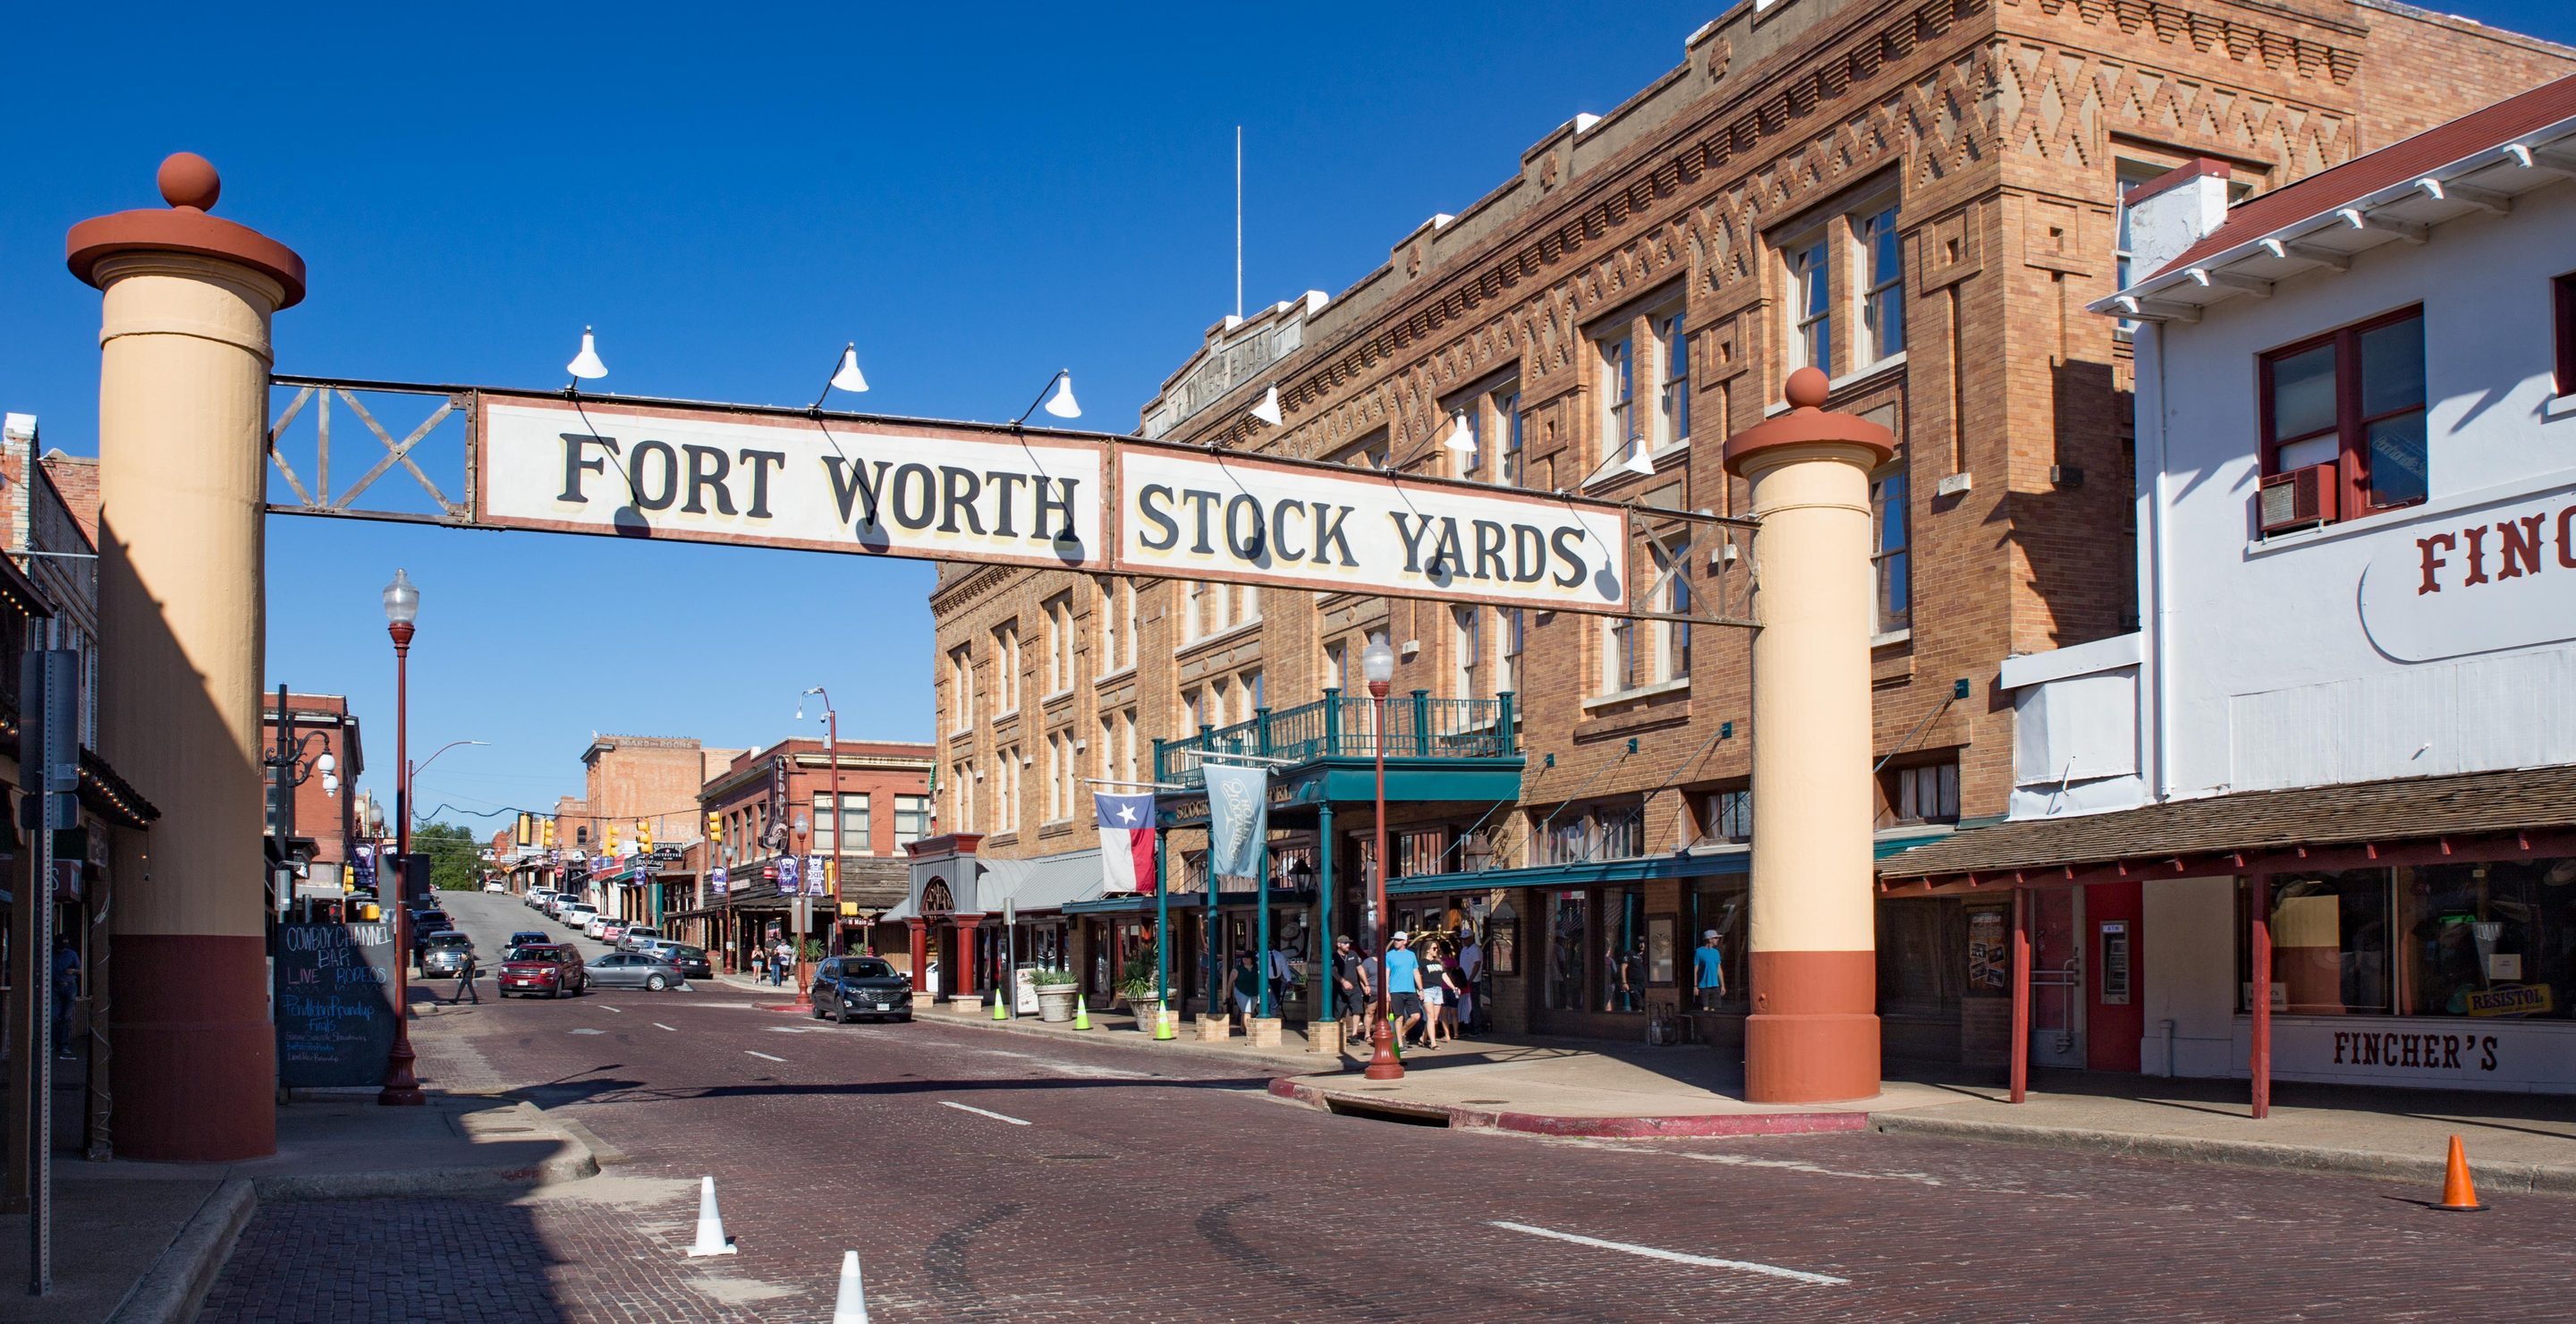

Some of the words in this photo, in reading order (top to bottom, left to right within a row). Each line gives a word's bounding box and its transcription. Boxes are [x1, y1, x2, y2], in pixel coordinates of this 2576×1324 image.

[555, 432, 786, 521] FORT
[820, 454, 1080, 543] WORTH
[1137, 483, 1360, 568] STOCK
[1388, 510, 1589, 589] YARDS
[619, 738, 649, 747] BOARD
[659, 739, 693, 749] ROOMS
[778, 757, 786, 817] LEDDY
[854, 918, 867, 926] Main
[286, 926, 334, 952] COWBOY
[318, 948, 350, 969] BAR
[287, 966, 320, 984] LIVE
[336, 966, 386, 984] RODEOS
[2471, 987, 2544, 1011] RESISTOL
[2333, 1031, 2498, 1072] FINCHER'S
